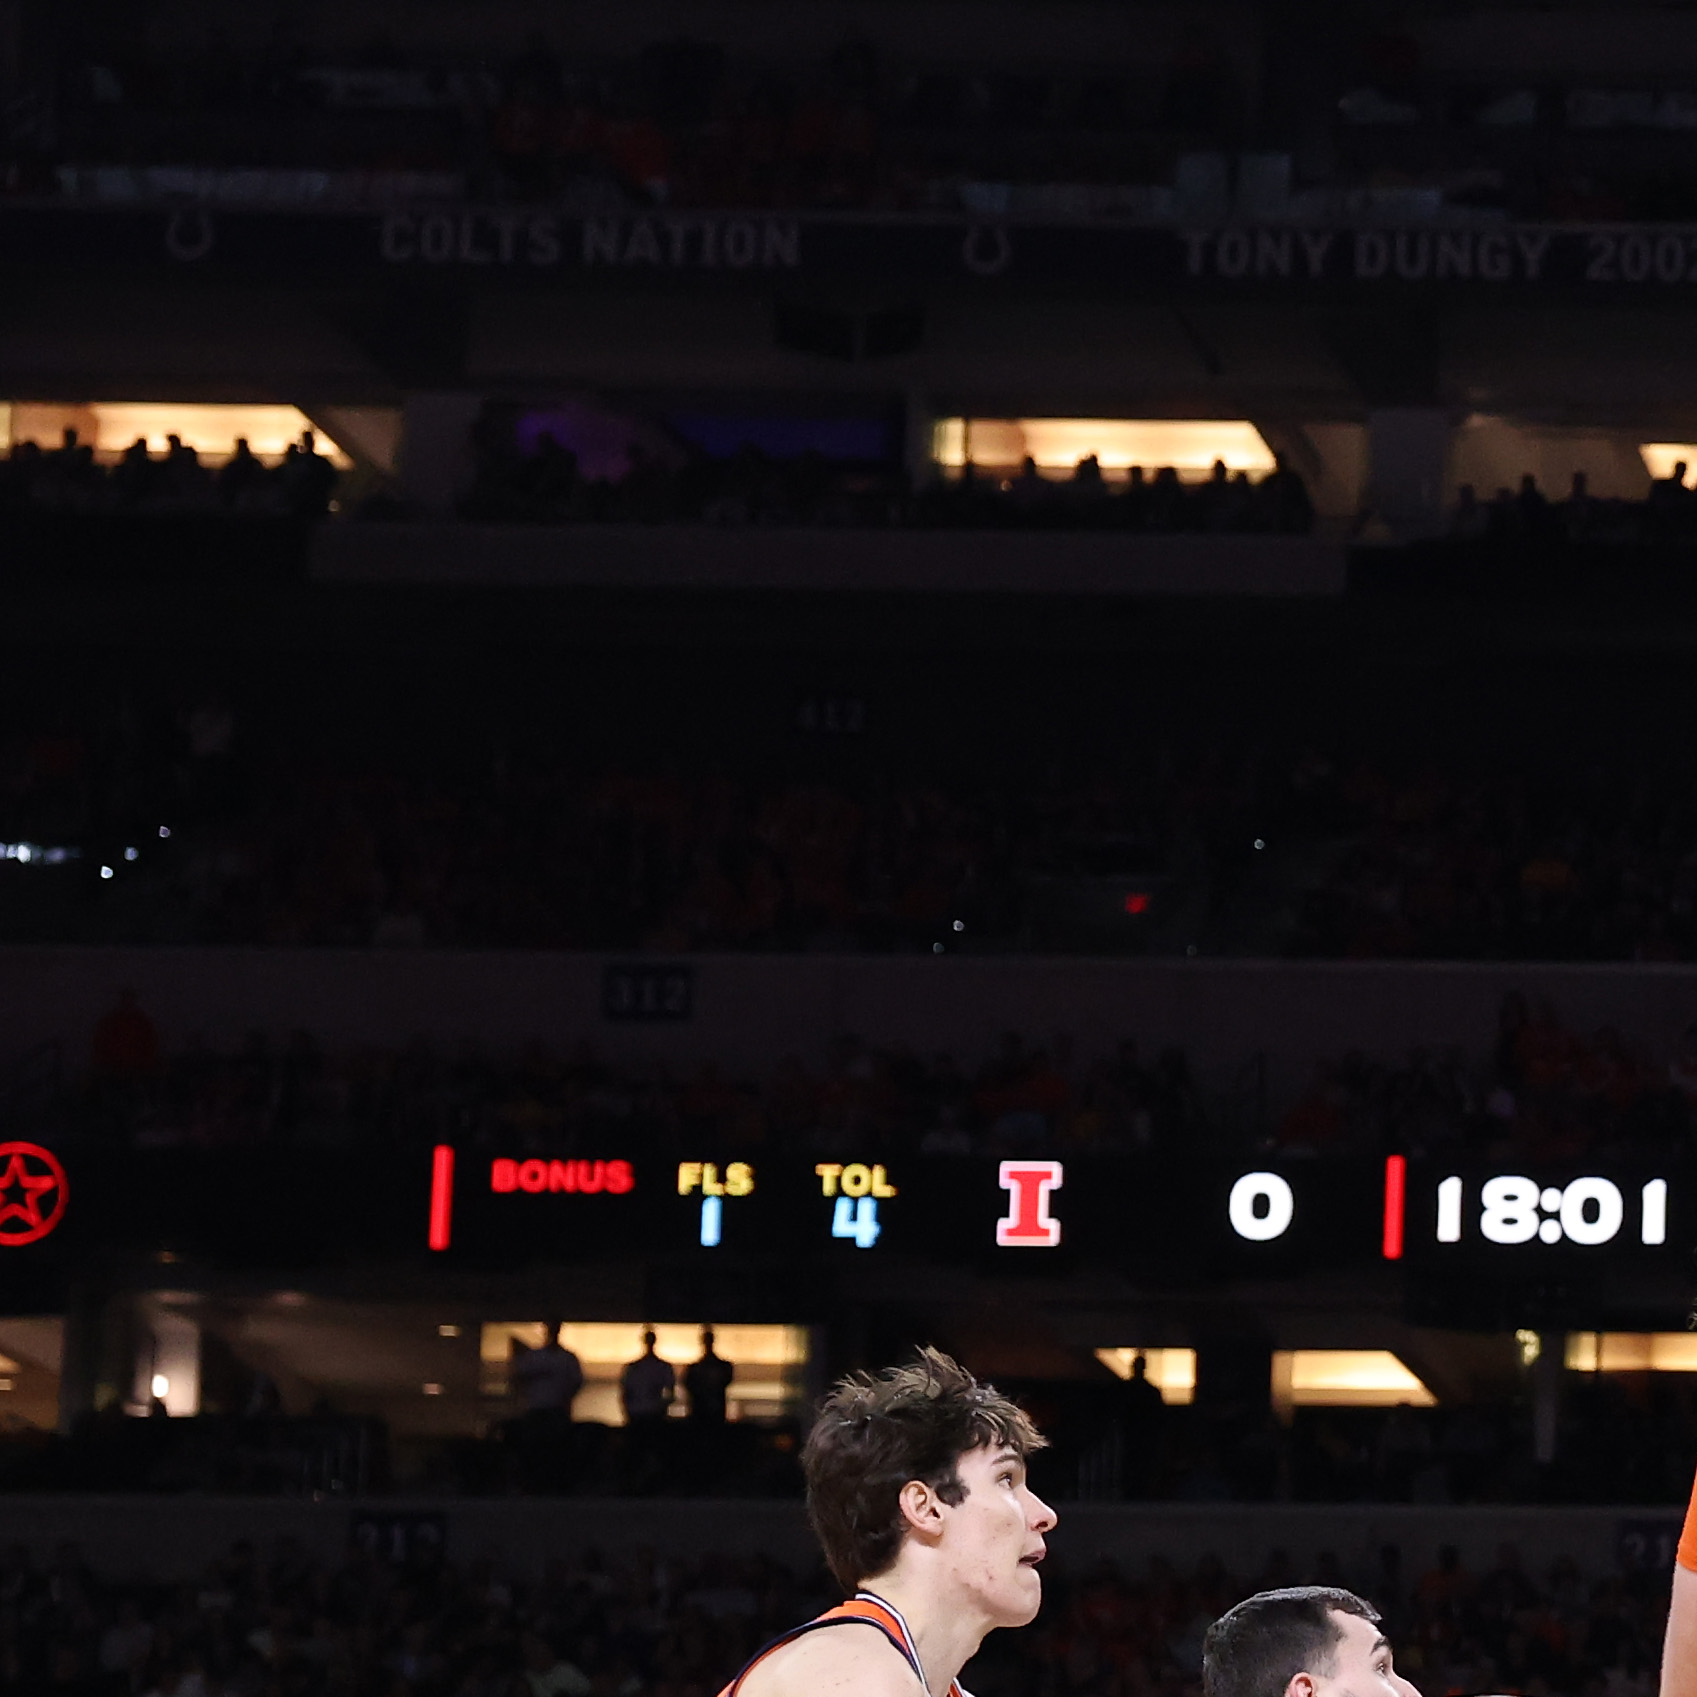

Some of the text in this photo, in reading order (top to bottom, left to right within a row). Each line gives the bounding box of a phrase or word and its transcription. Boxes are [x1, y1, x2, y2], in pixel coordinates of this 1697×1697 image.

[380, 211, 800, 268] COLTS NATION
[1182, 229, 1333, 278] TONY
[1353, 231, 1552, 280] DUNGY
[490, 1157, 635, 1195] BONUS
[676, 1160, 756, 1197] FLS
[815, 1161, 896, 1199] TOL
[699, 1195, 724, 1248] 1
[830, 1196, 881, 1249] 4
[1227, 1170, 1295, 1242] 0
[1436, 1174, 1668, 1246] 18:01
